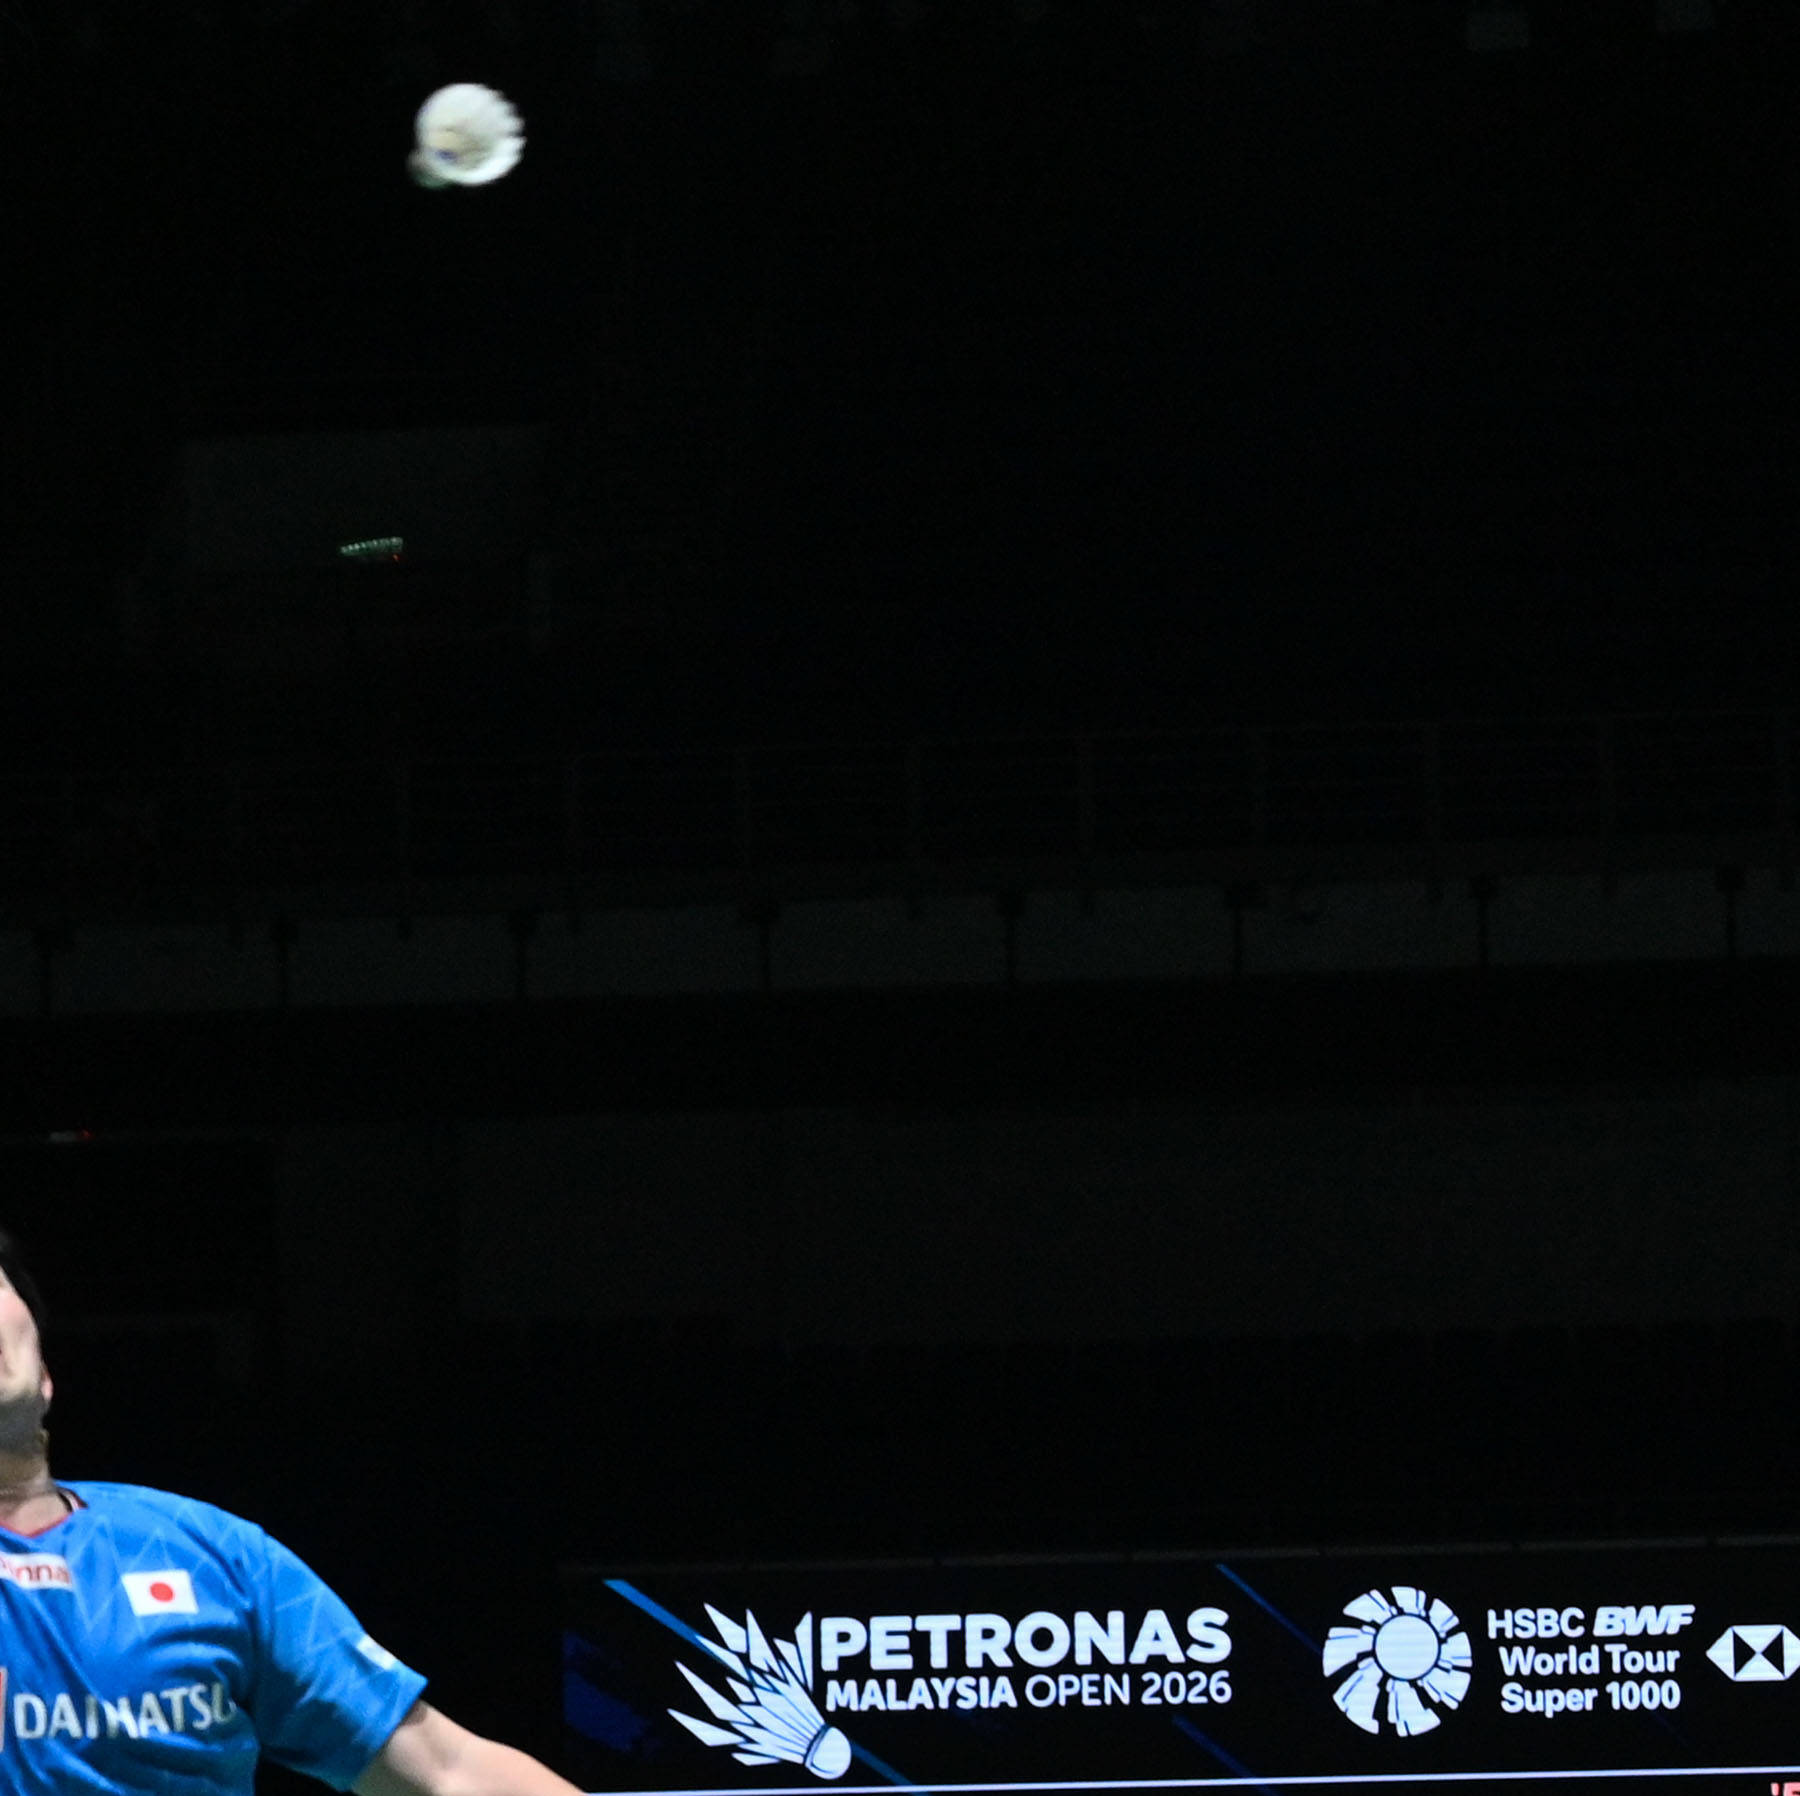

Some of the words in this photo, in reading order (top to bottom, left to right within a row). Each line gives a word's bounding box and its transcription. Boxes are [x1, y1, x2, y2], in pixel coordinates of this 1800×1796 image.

[820, 1607, 1232, 1671] PETRONAS
[1487, 1608, 1585, 1639] HSBC
[1593, 1604, 1695, 1636] BWF
[1500, 1646, 1599, 1676] World
[1604, 1643, 1680, 1673] Tour
[826, 1675, 1018, 1711] MALAYSIA
[1024, 1672, 1130, 1708] OPEN
[1141, 1671, 1232, 1705] 2026
[1500, 1682, 1598, 1718] Super
[1605, 1681, 1681, 1710] 1000
